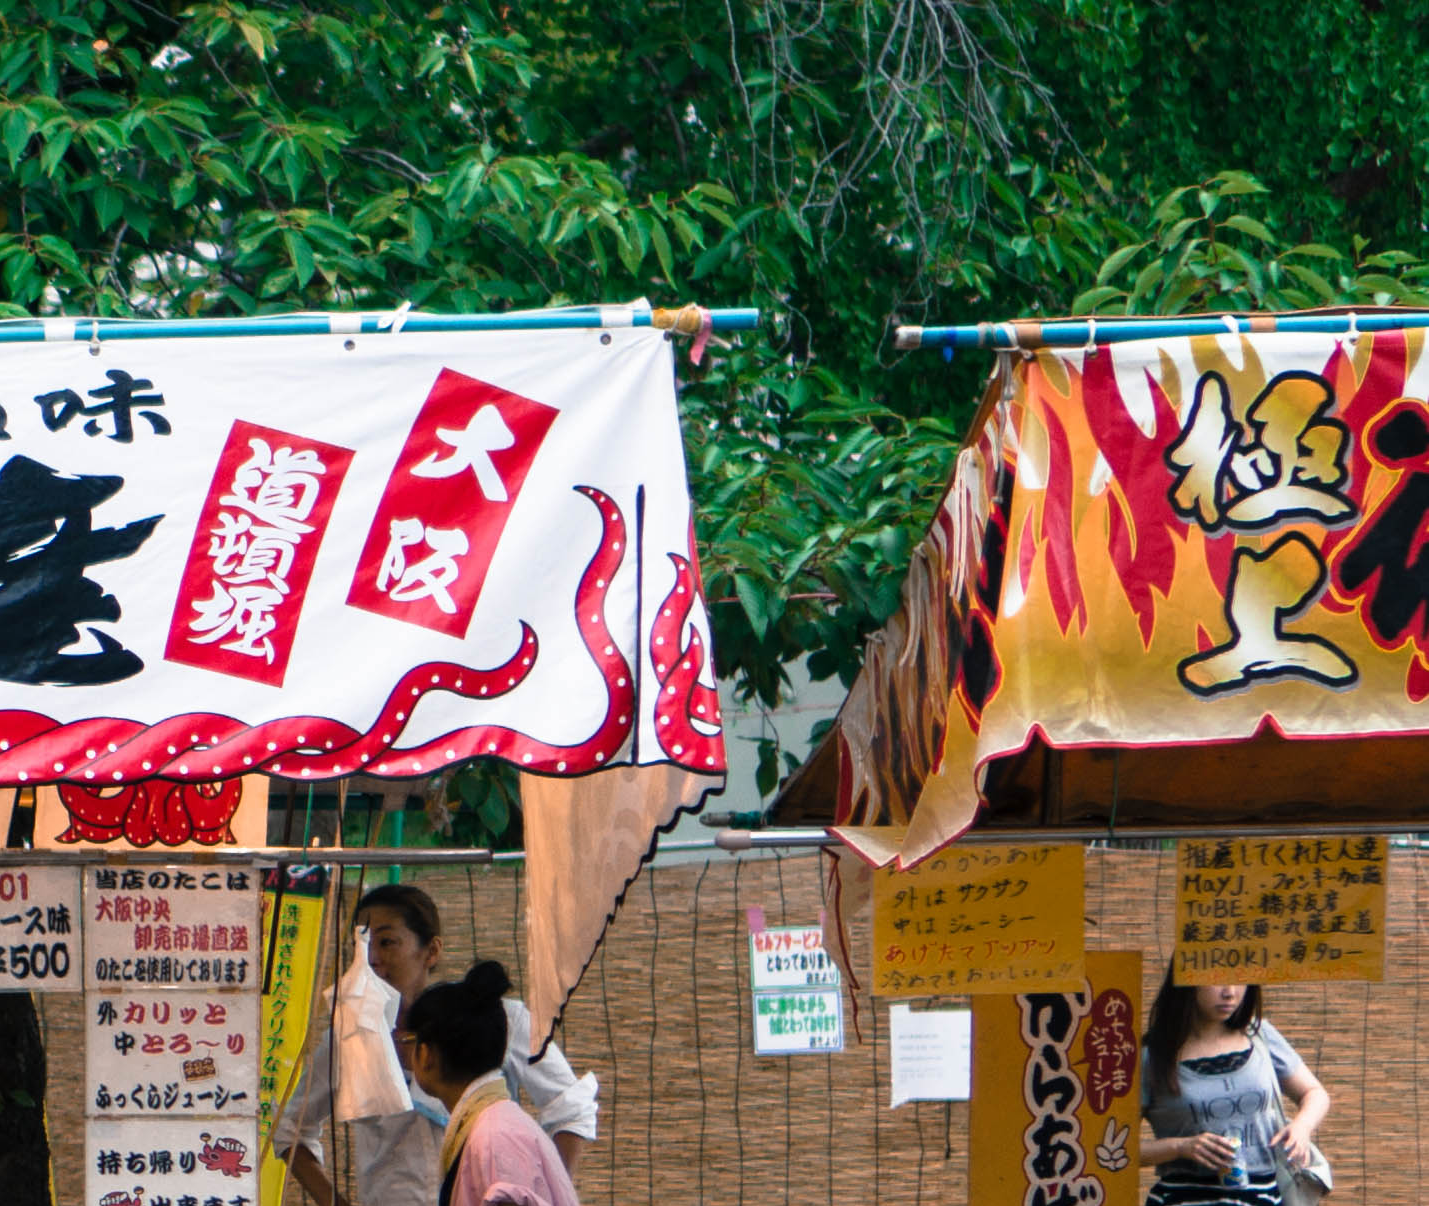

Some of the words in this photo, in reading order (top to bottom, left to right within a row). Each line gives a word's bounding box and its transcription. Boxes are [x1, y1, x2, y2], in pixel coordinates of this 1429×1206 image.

[376, 403, 517, 614] 大阪
[189, 438, 329, 665] 道頓堀
[1182, 837, 1384, 869] 推薦してくれた人達
[94, 870, 250, 891] 当店のたこは
[893, 886, 947, 911] 外は
[957, 878, 1030, 903] サクサク
[94, 896, 171, 923] 大阪中央
[134, 925, 249, 952] 卸売市場直送
[893, 917, 937, 936] 中は
[949, 913, 1037, 934] ジューシー
[95, 957, 248, 983] のたこを使用しております
[1103, 998, 1135, 1091] めちゃうま
[1089, 1026, 1112, 1110] ジューシー
[95, 1083, 248, 1111] ふっくらジューシー
[96, 1149, 197, 1176] 持ち帰り
